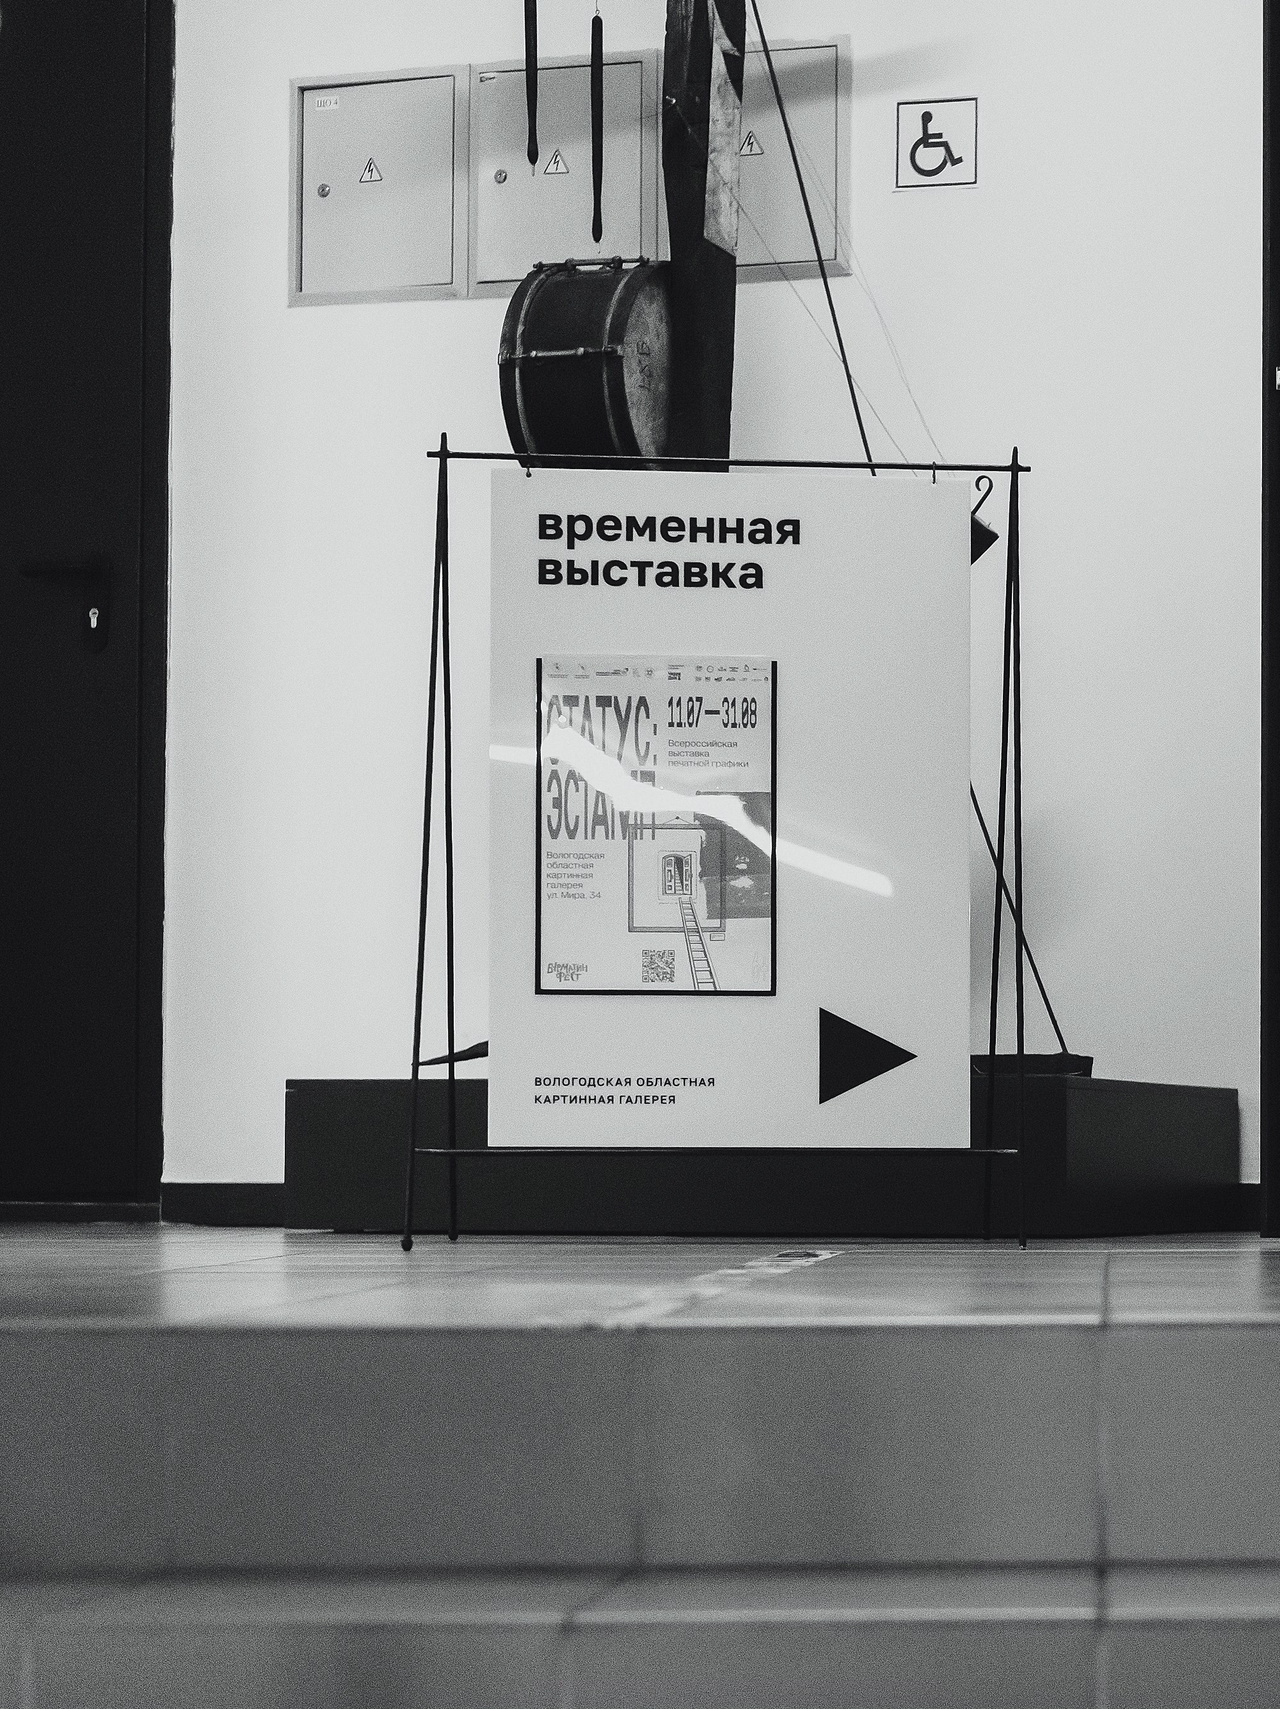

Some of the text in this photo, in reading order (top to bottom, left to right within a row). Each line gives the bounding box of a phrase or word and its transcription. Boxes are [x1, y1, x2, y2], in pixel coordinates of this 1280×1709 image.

[538, 513, 801, 550] временная
[538, 558, 764, 589] выставка
[667, 696, 757, 729] 11.07—31.08
[668, 739, 738, 748] Всероссийская
[667, 759, 749, 768] печатной графики
[546, 851, 605, 860] Вологодская
[546, 861, 594, 869] областная
[546, 872, 594, 880] картинная
[546, 882, 583, 890] галерея
[589, 891, 601, 899] 34
[534, 1076, 715, 1088] ВОЛОГОДСКАЯ ОБЛАСТНАЯ
[534, 1094, 676, 1105] КАРТИННАЯ ГАЛЕРЕЯ
